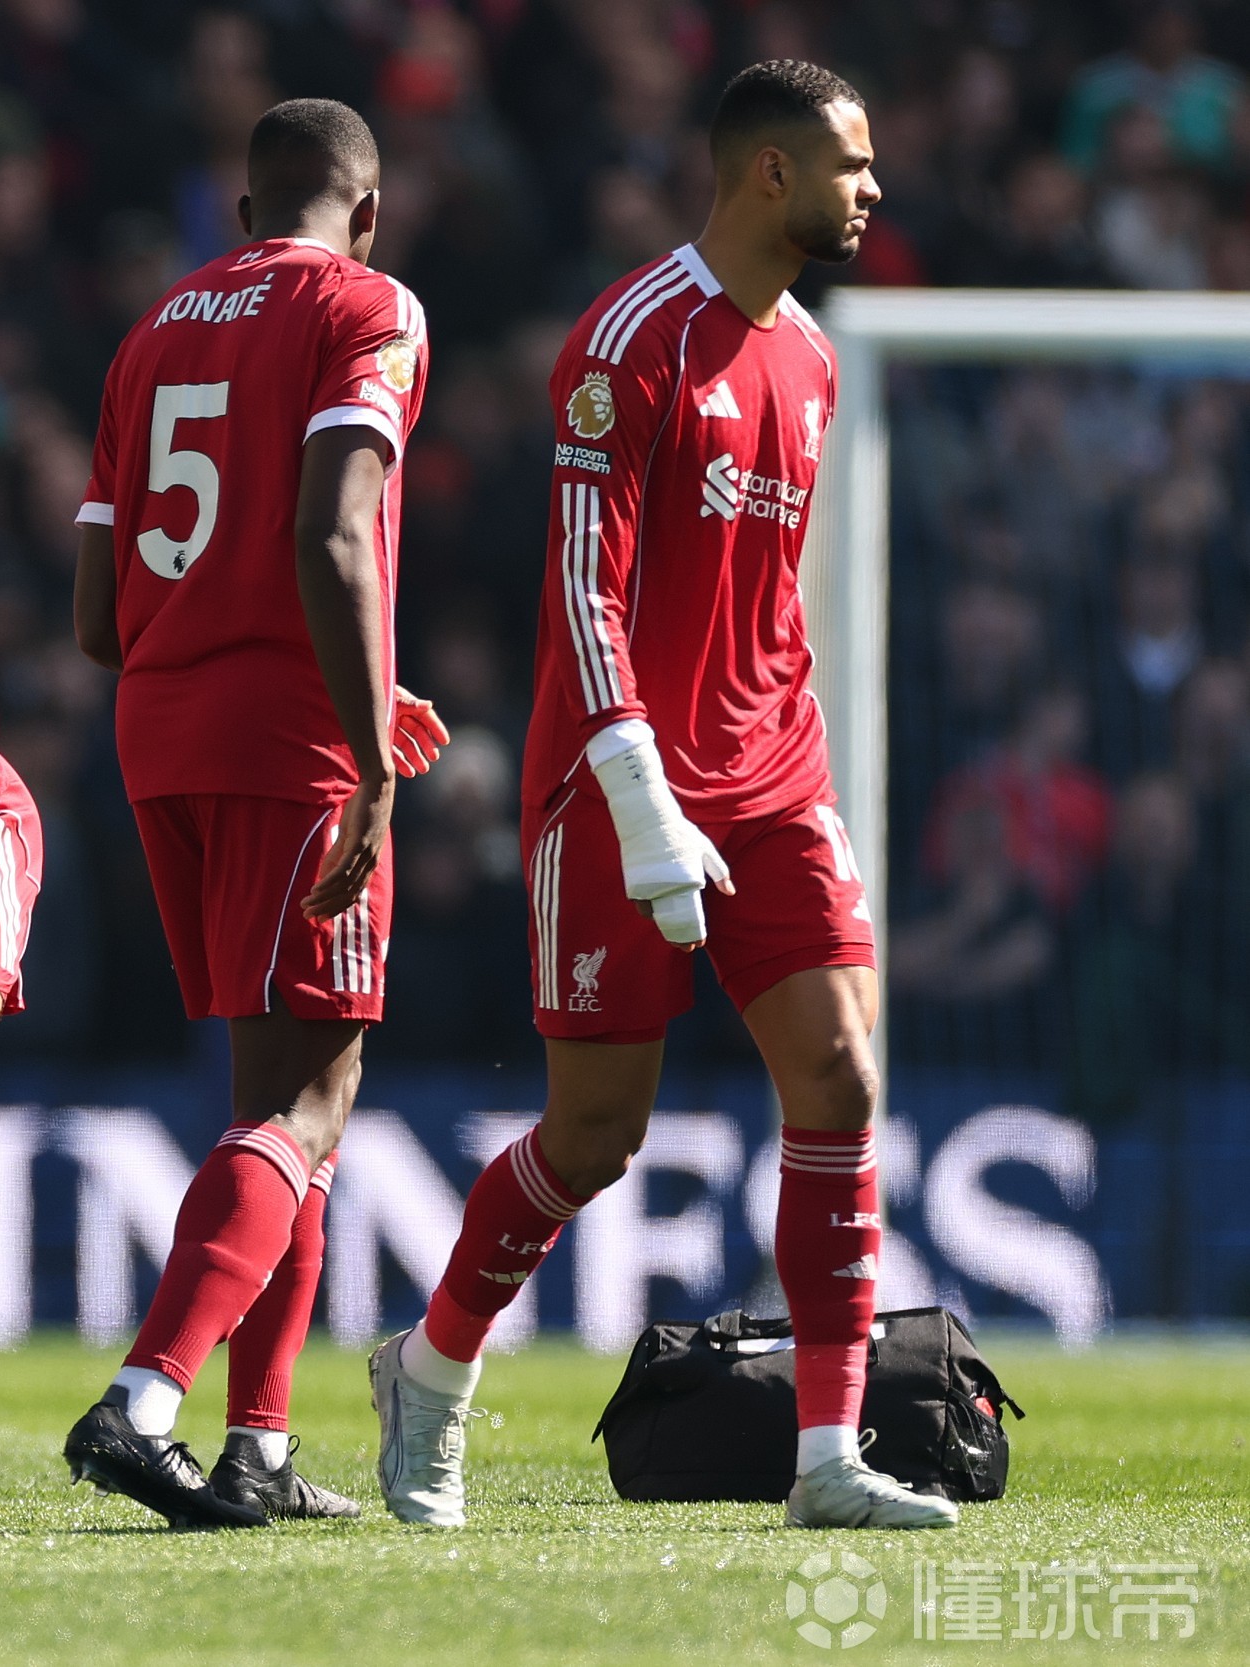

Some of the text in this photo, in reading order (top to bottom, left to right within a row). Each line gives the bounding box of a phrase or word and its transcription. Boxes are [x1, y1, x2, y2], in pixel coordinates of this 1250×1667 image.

[153, 273, 275, 329] KONATÉ
[556, 443, 607, 463] No room
[554, 454, 610, 475] for racism
[137, 381, 229, 580] 5
[830, 1212, 881, 1228] LFC
